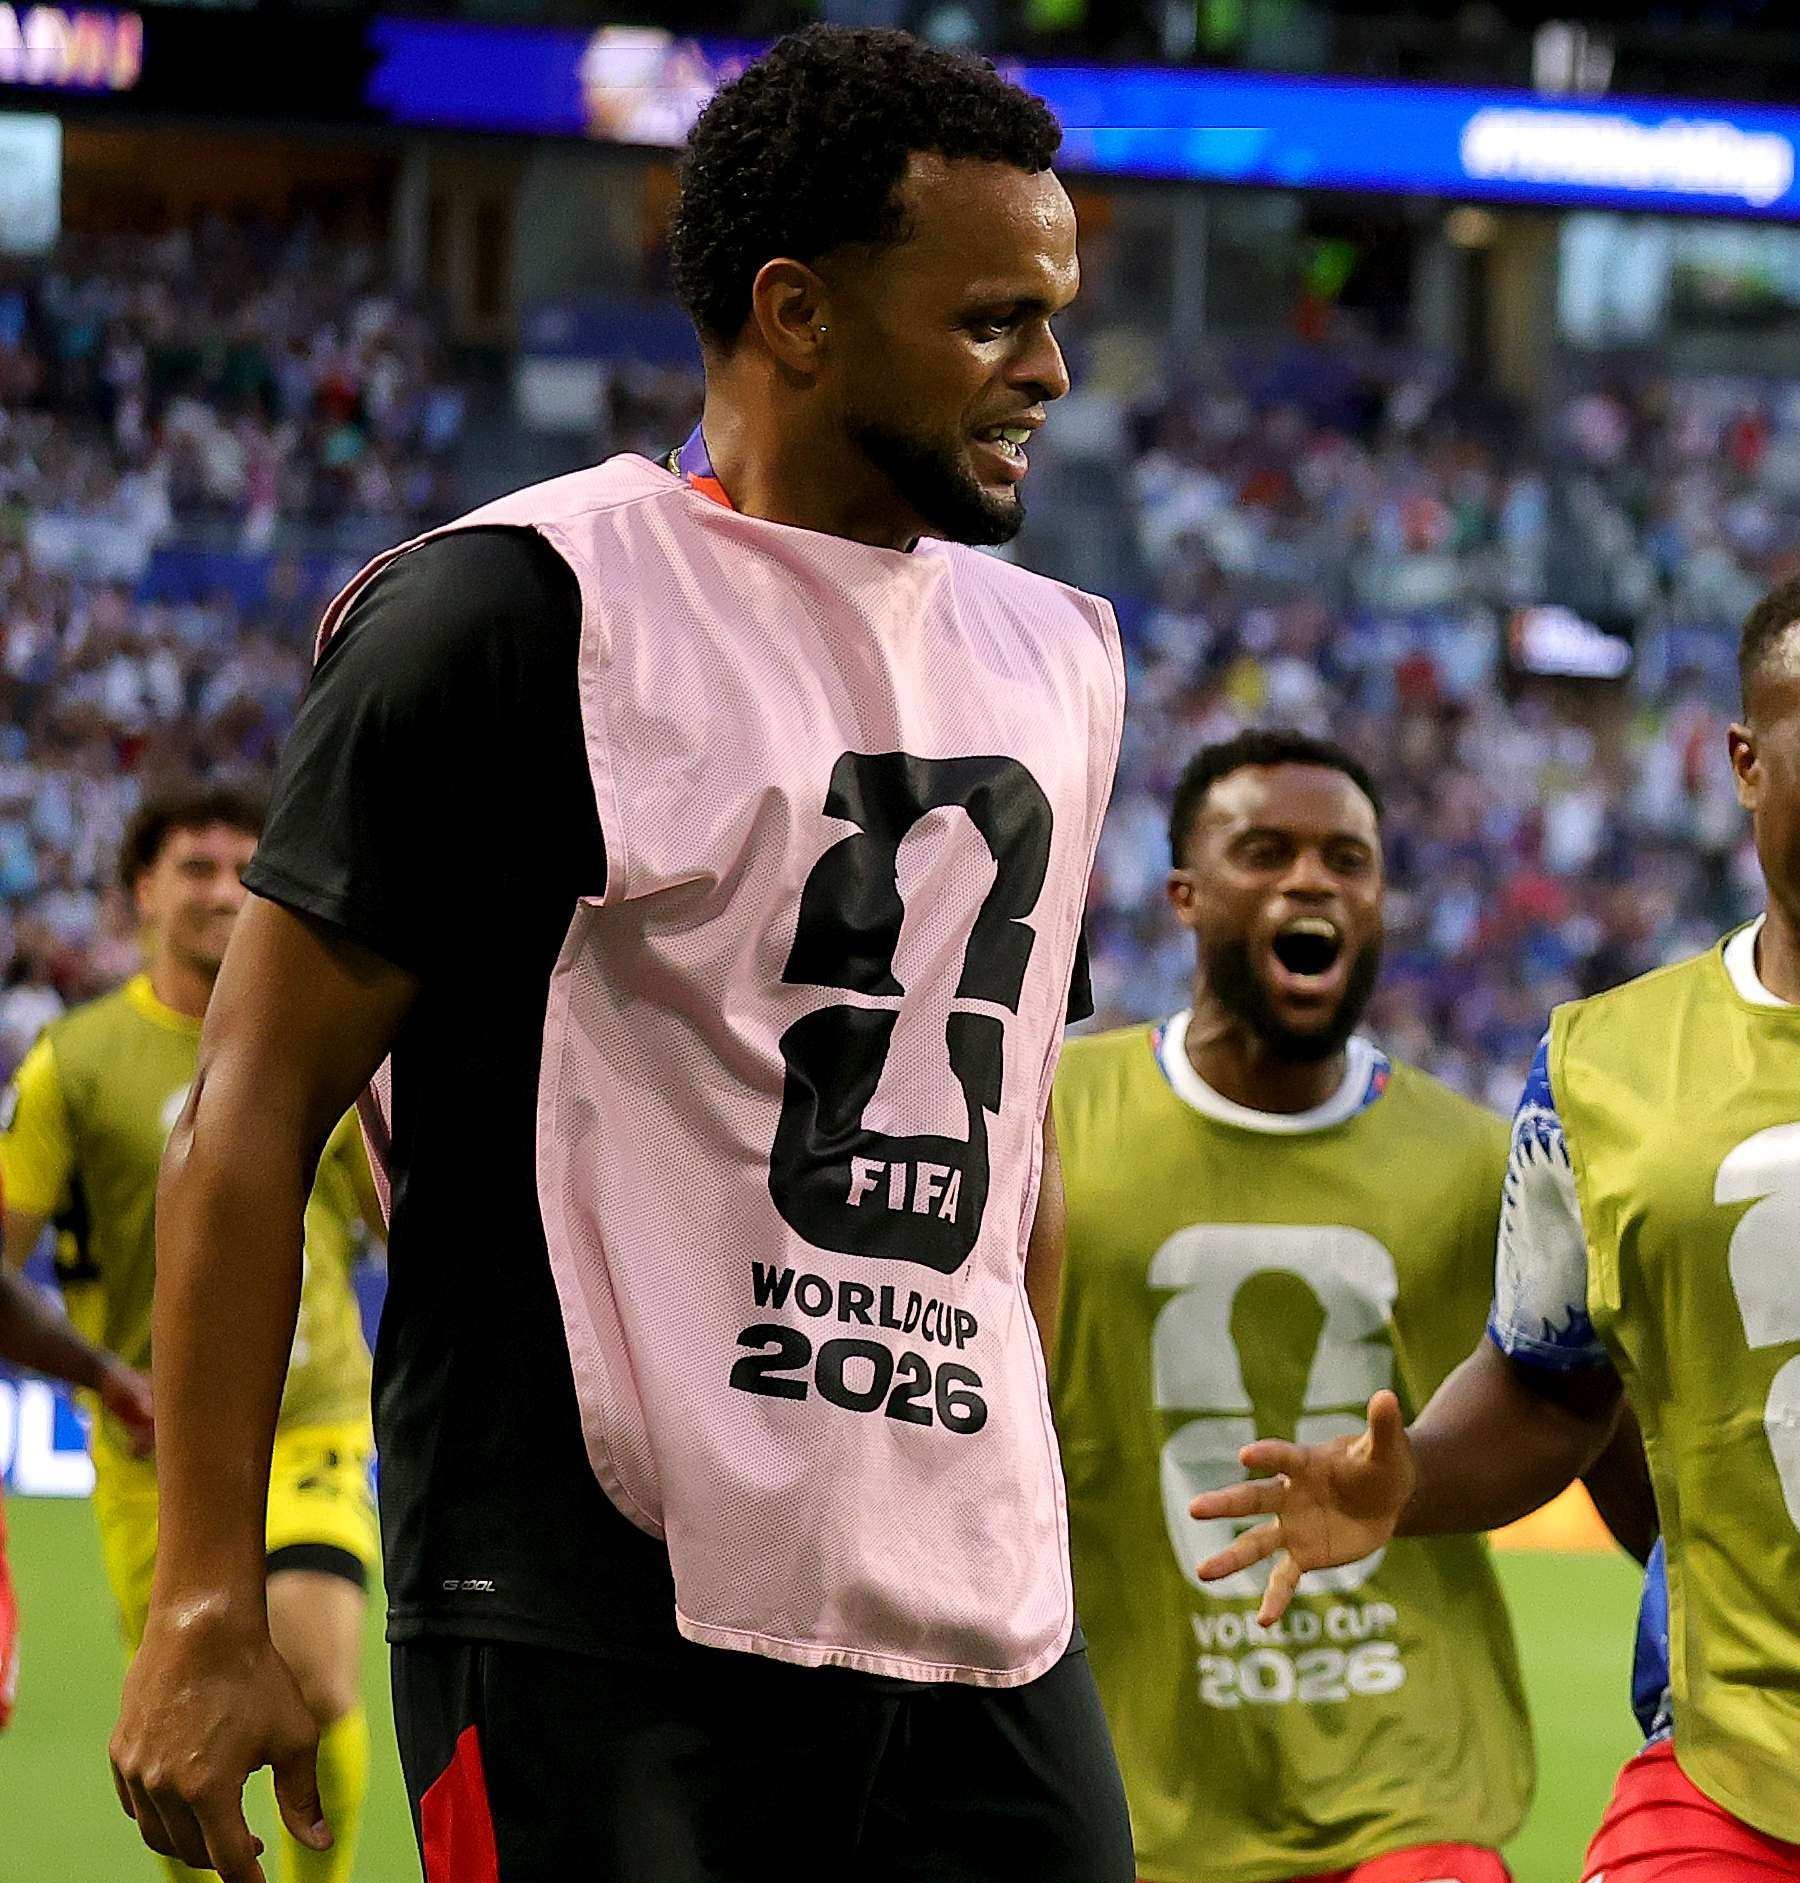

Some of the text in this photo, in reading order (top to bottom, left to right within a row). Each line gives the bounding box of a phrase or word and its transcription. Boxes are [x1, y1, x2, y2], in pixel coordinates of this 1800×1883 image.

[846, 1155, 962, 1224] FIFA
[729, 1323, 988, 1435] 2026
[1197, 1639, 1408, 1709] 2026
